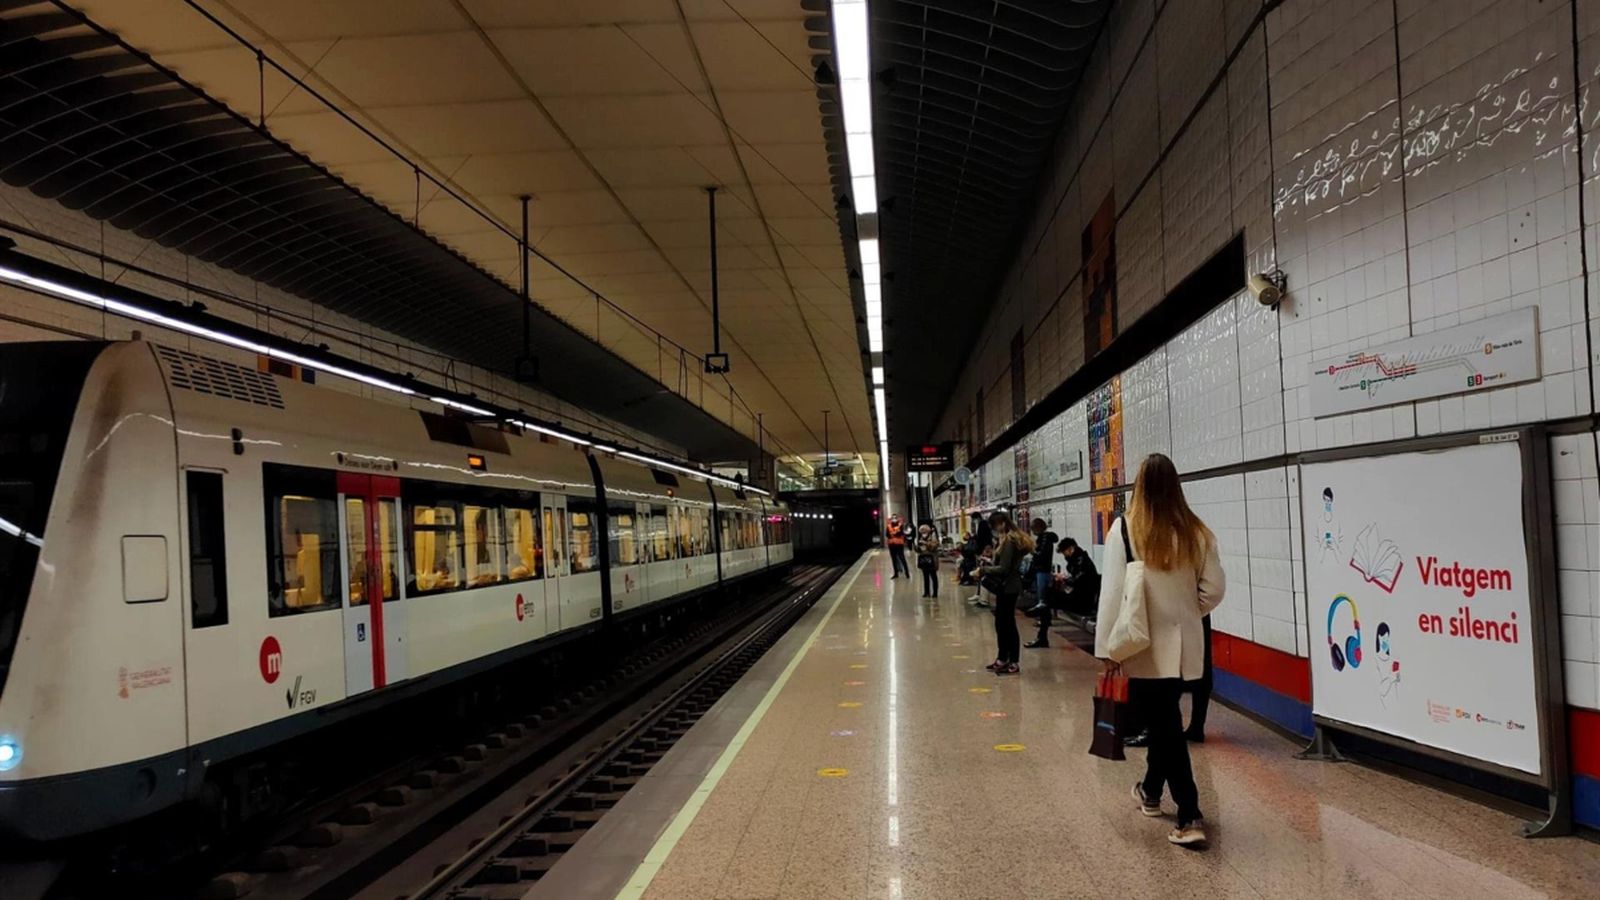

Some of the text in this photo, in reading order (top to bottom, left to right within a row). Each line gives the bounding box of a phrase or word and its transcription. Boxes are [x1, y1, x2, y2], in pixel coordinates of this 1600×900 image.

[1416, 556, 1512, 598] Viatgem
[1418, 606, 1518, 644] en silenci
[267, 652, 281, 674] m
[300, 689, 317, 706] FGV
